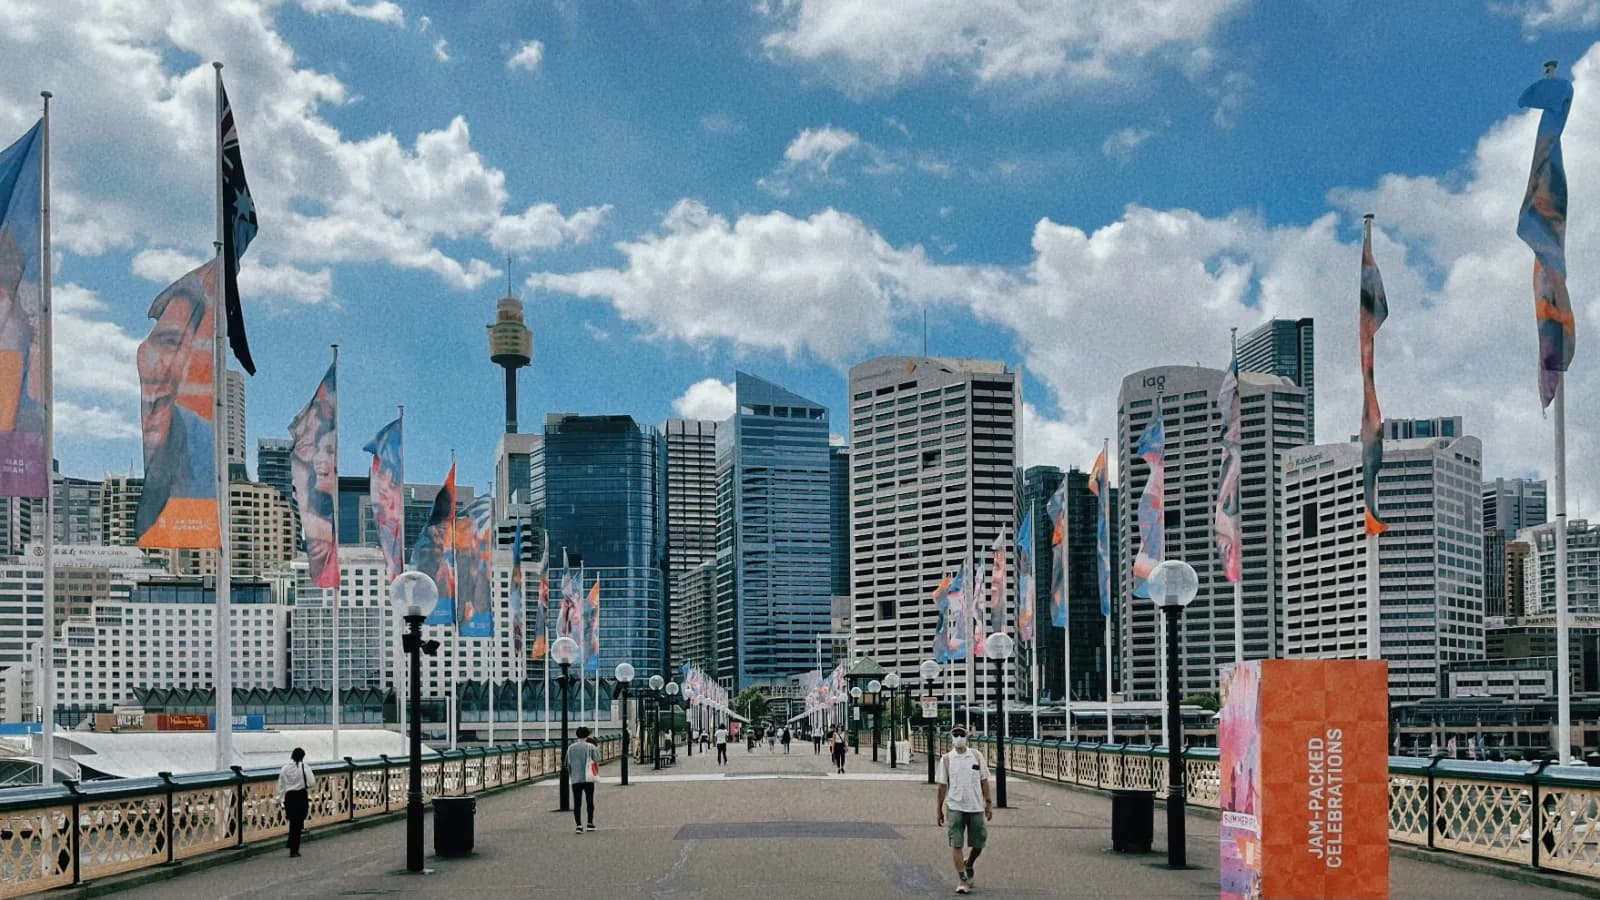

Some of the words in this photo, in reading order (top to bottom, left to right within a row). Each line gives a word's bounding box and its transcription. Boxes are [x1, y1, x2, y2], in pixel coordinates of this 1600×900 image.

[1143, 375, 1166, 391] iag
[1308, 738, 1324, 859] JAM-PACKED
[1326, 728, 1343, 868] CELEBRATIONS
